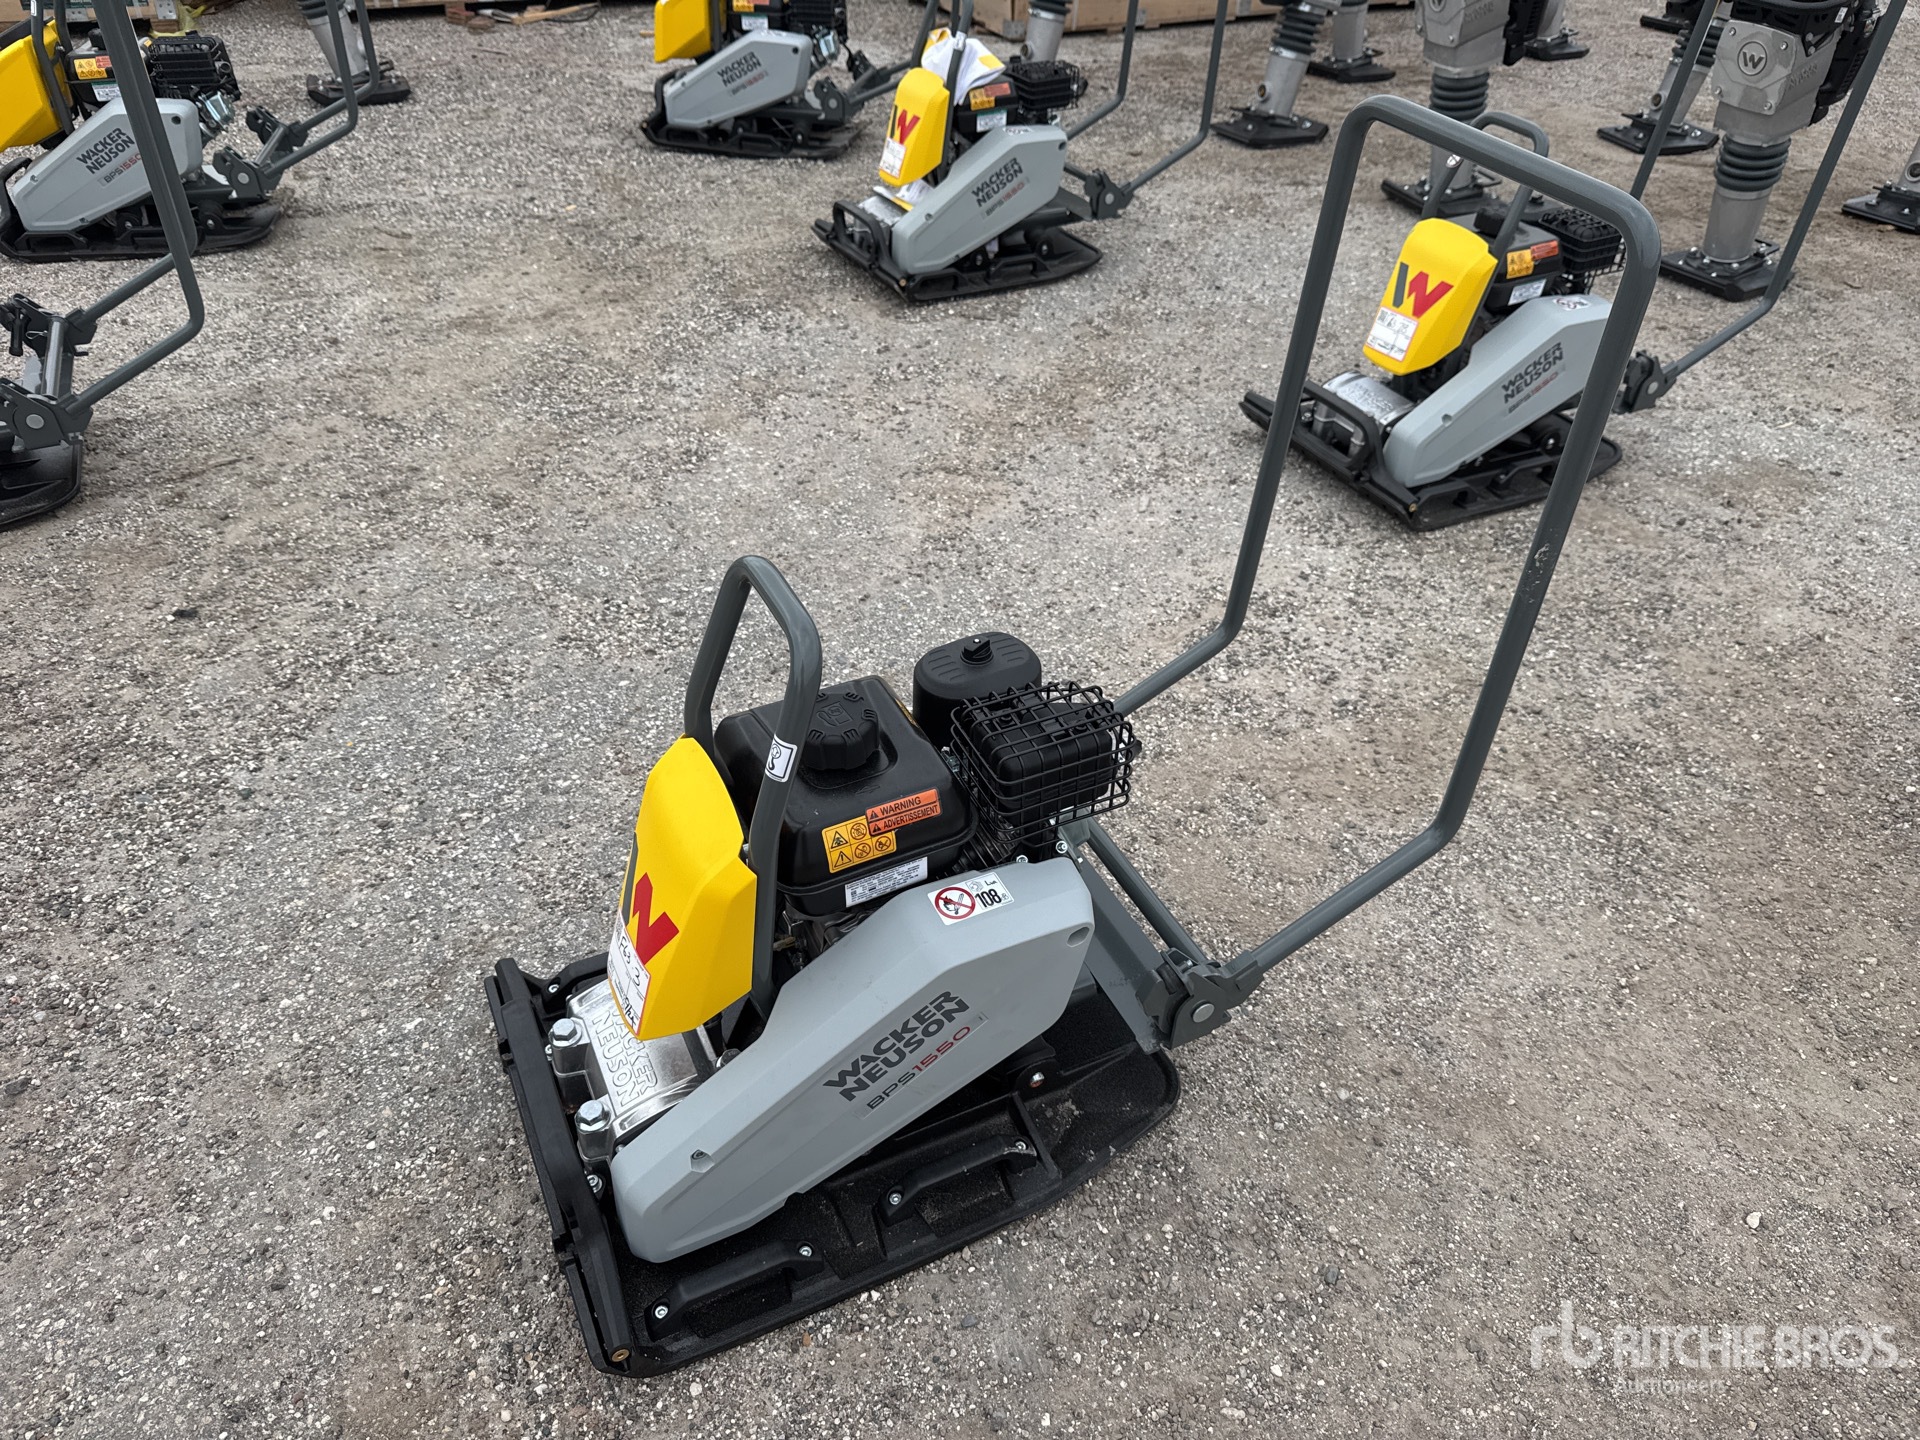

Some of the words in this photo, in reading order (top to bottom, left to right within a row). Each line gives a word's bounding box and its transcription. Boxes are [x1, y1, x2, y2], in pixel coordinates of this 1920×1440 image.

[717, 50, 757, 78] WACKER
[722, 57, 762, 88] NEUSON
[76, 128, 127, 165] WACKER
[85, 135, 135, 175] NEUSON
[971, 157, 1019, 197] WACKER
[976, 164, 1023, 207] NEUSON
[1501, 341, 1562, 392] WACKER
[1504, 350, 1564, 404] NEUSON
[880, 795, 921, 816] WARNING
[883, 804, 939, 830] ADVERTISSEMENT
[974, 888, 1002, 908] 108
[592, 1010, 640, 1107] NEUSON
[823, 990, 959, 1088] WACKER
[839, 997, 970, 1103] NEUSON
[867, 1026, 971, 1110] BPS1550
